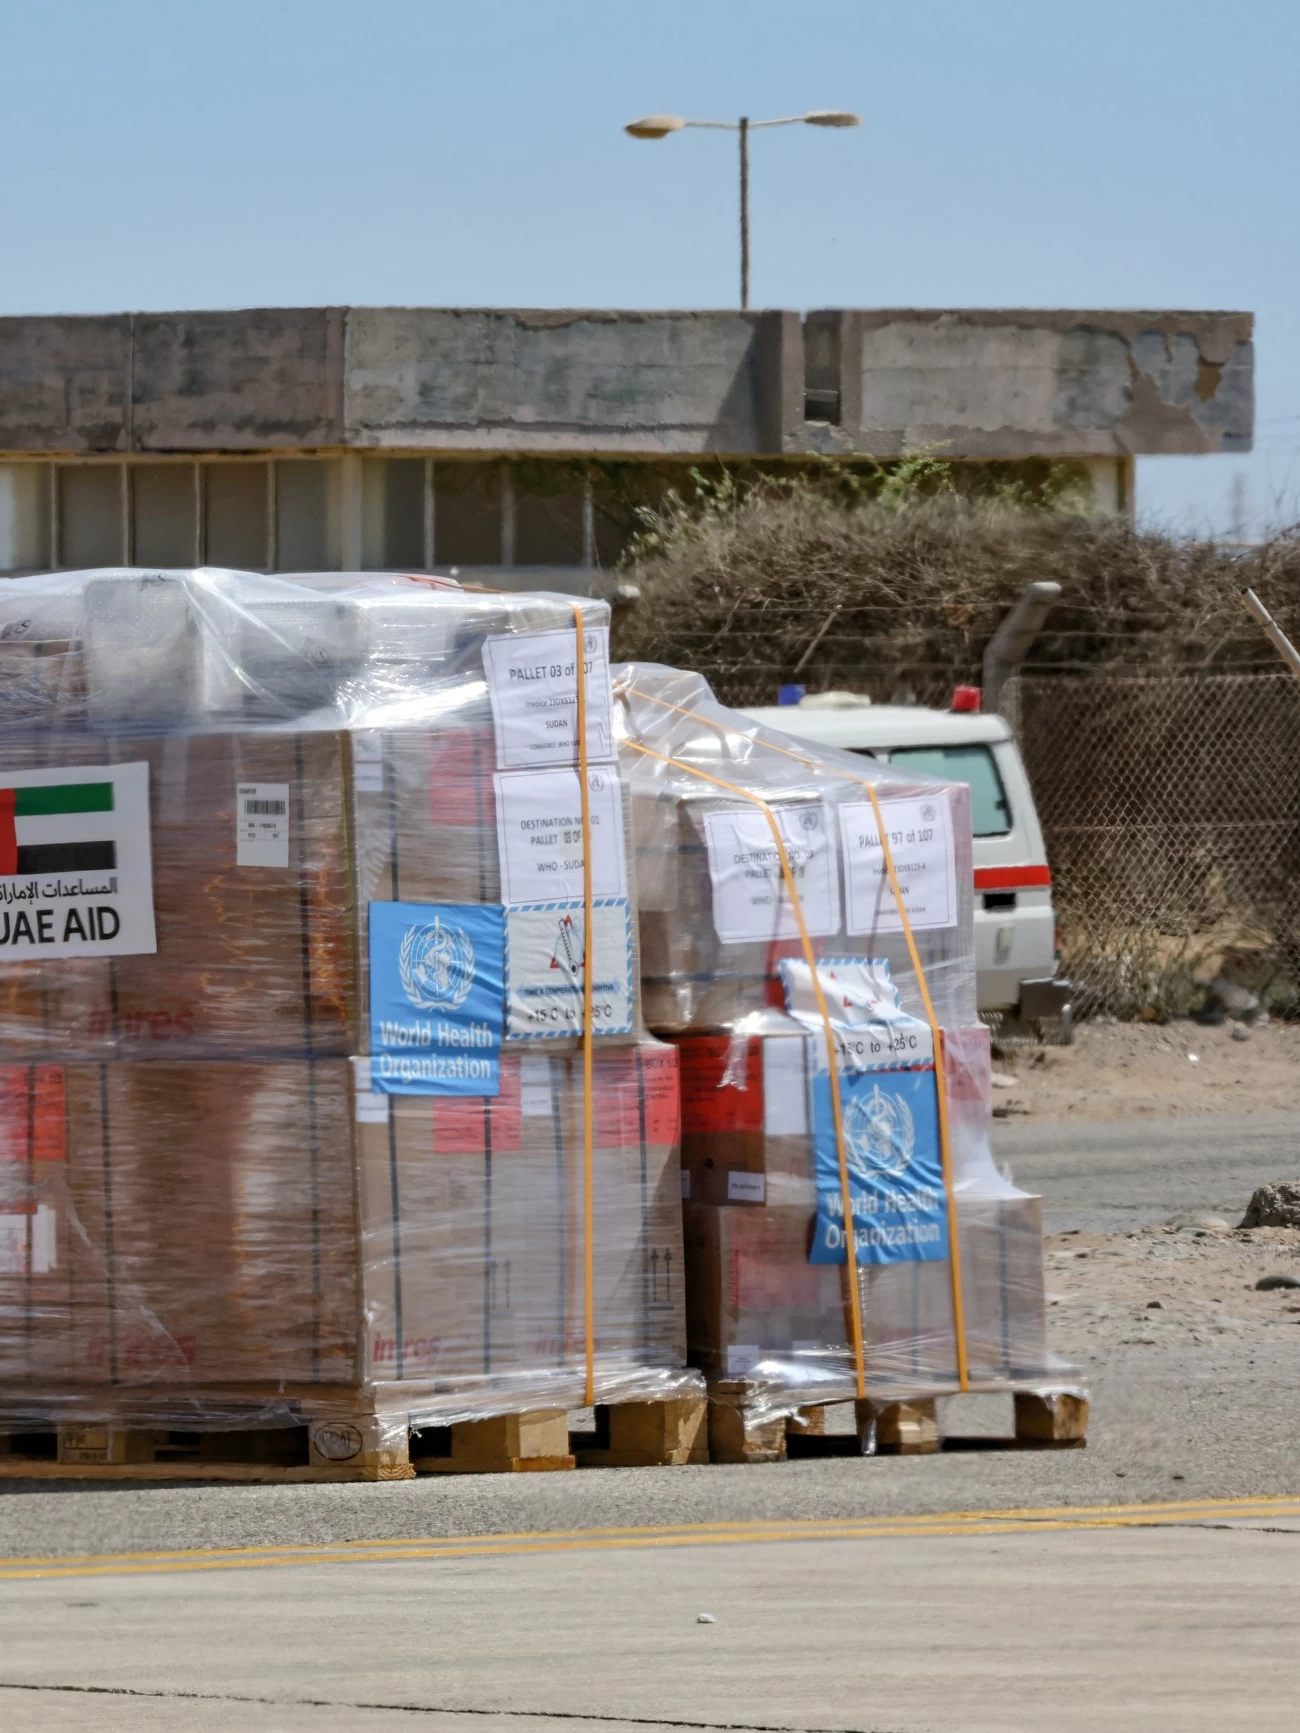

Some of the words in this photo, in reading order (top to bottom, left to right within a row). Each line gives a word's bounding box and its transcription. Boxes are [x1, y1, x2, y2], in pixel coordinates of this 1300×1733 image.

[509, 666, 547, 681] PALLET
[550, 665, 562, 678] 03
[564, 664, 575, 677] of
[545, 720, 568, 729] SUDAN
[520, 817, 573, 830] DESTINATION
[531, 834, 558, 845] PALLET
[891, 832, 903, 844] 97
[906, 830, 915, 843] of
[917, 828, 933, 842] 107
[733, 851, 780, 864] DESTINATIO
[537, 862, 558, 872] WHO
[564, 859, 585, 869] SUDA
[42, 877, 118, 898] المساعدات
[63, 906, 121, 942] AID
[524, 988, 538, 996] TIME
[380, 1021, 432, 1048] World
[437, 1021, 493, 1048] Health
[870, 1042, 881, 1053] to
[380, 1053, 492, 1084] Organization
